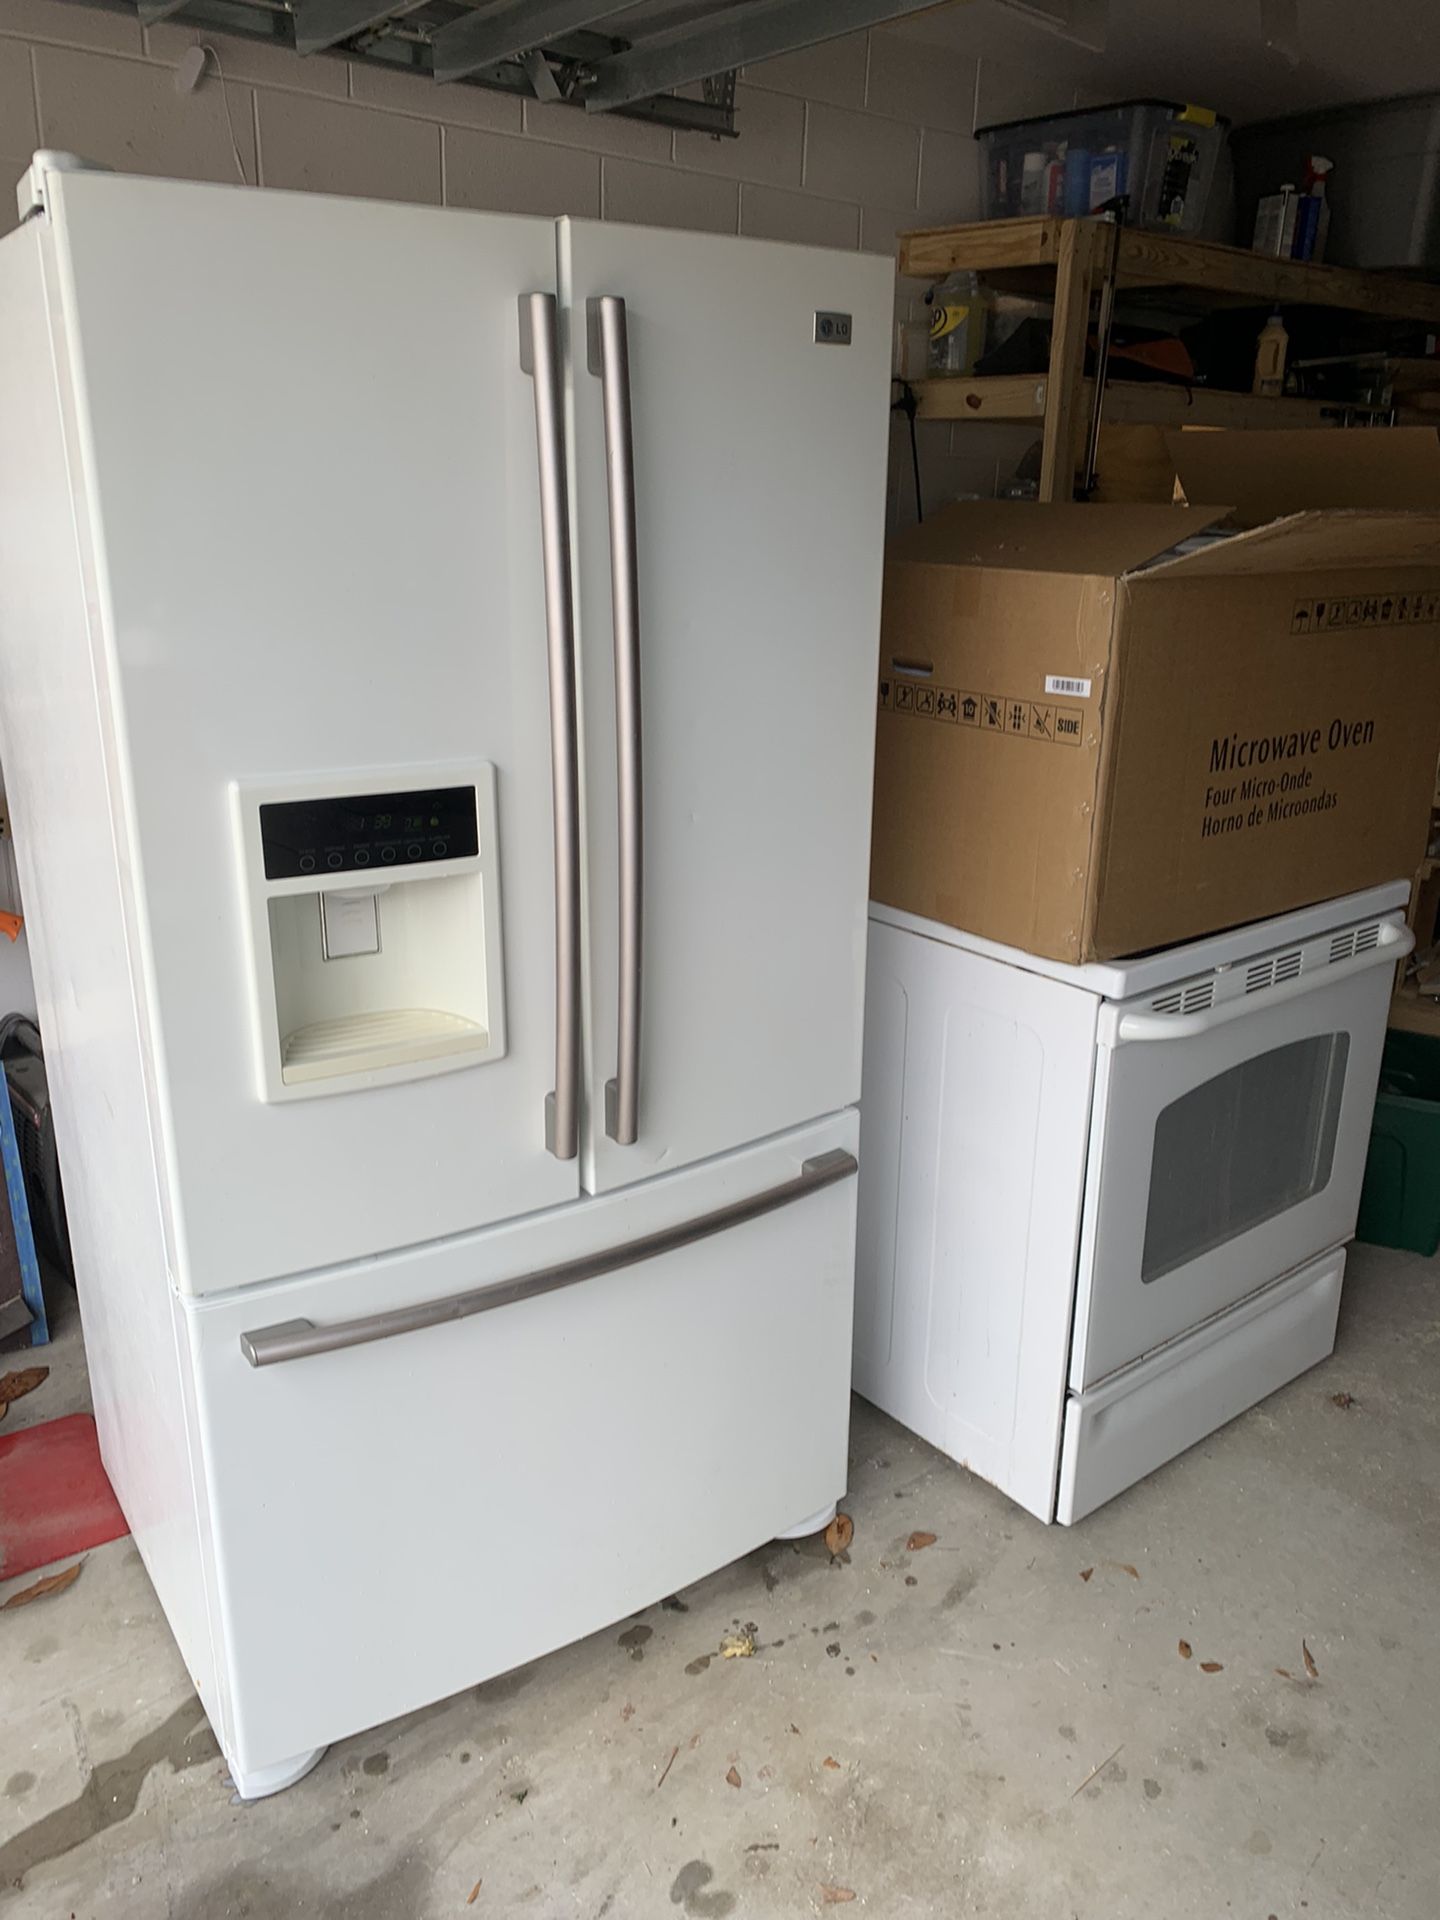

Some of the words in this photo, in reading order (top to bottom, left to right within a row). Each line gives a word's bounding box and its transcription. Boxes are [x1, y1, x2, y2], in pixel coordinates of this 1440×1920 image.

[1057, 718, 1080, 735] SIDE
[1209, 729, 1321, 773] Microwave
[1328, 718, 1375, 750] Oven
[1205, 786, 1236, 808] Four
[1240, 766, 1313, 800] Micro-Onde
[1201, 814, 1244, 838] Horno
[1247, 804, 1264, 827] de
[1267, 788, 1338, 823] Microondas
